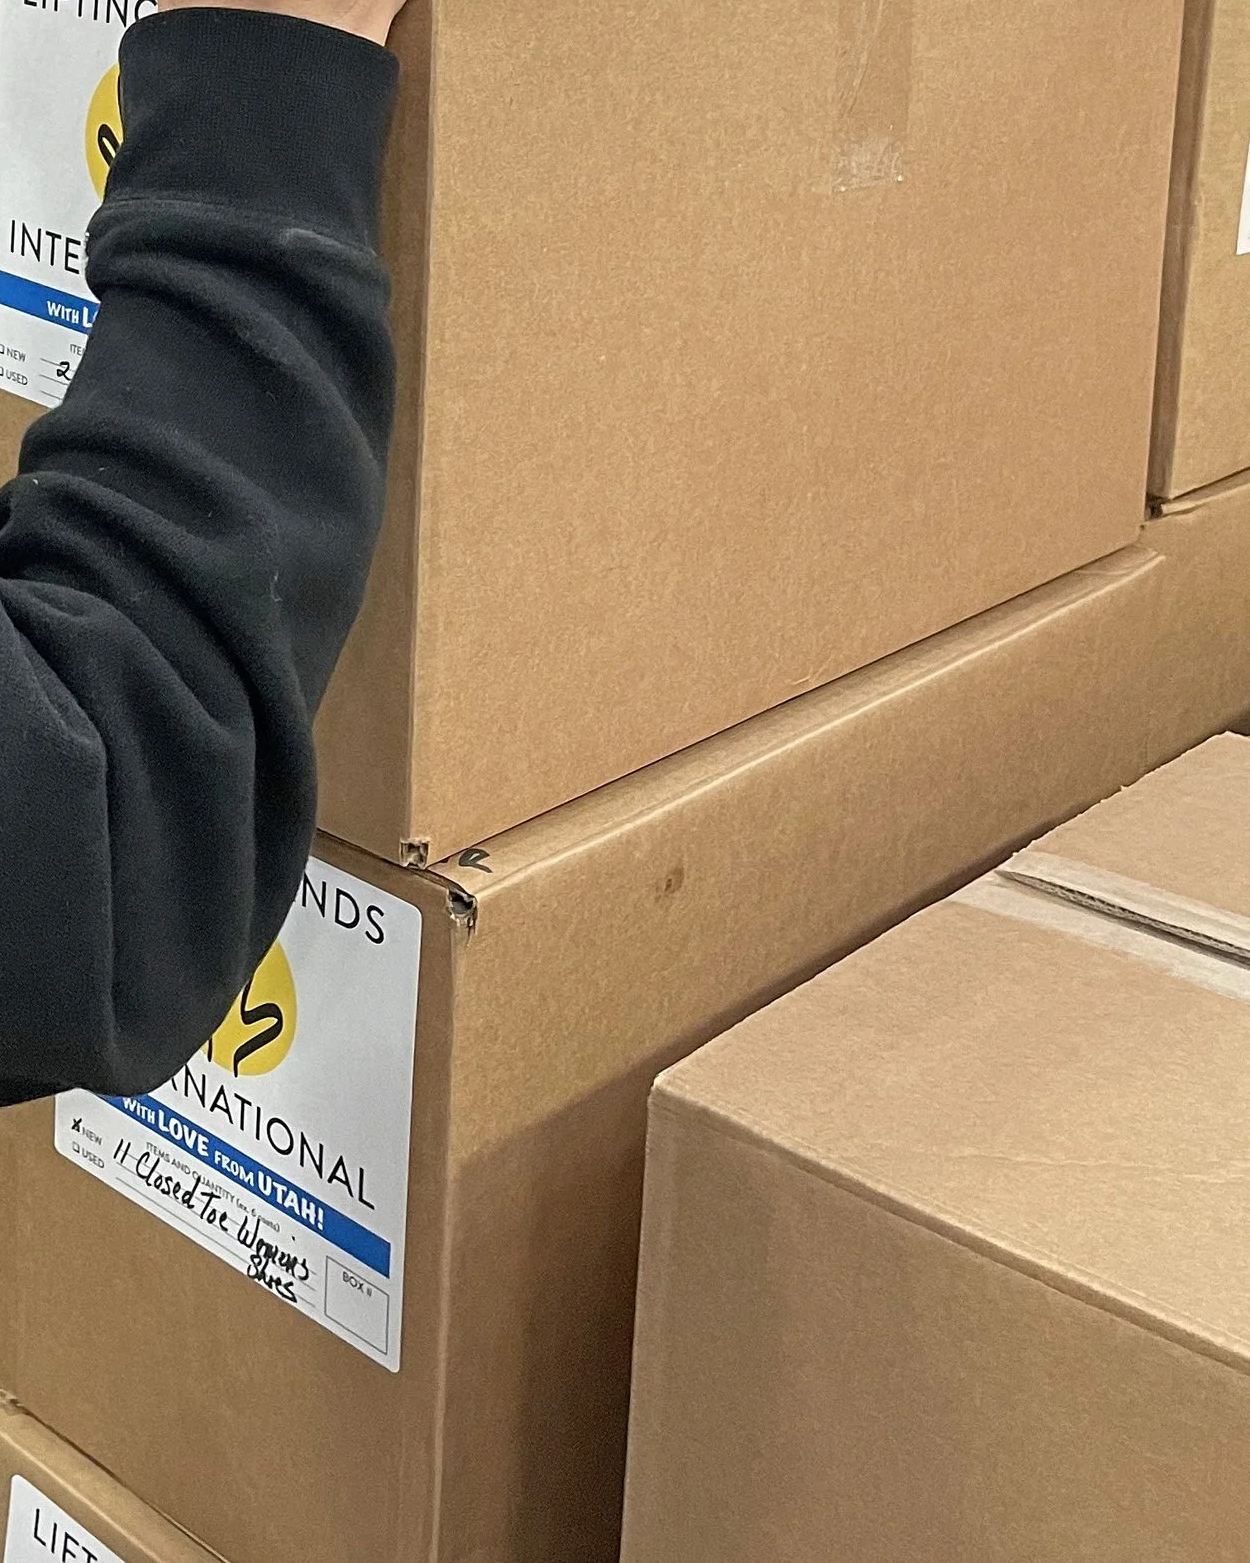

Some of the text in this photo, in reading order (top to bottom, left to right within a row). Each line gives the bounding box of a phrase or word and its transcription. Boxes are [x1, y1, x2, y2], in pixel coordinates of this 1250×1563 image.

[46, 300, 80, 324] WITH
[6, 346, 26, 362] NEW
[70, 343, 86, 357] ITE
[5, 368, 29, 386] USED
[301, 872, 386, 945] NDS
[81, 1126, 103, 1146] NEW
[171, 1065, 376, 1211] NATIONAL
[81, 1147, 105, 1169] USED
[122, 1097, 325, 1232] WITH LOVE FROM UTAH!
[146, 1141, 171, 1163] ITEMS
[171, 1158, 191, 1176] AND
[135, 1151, 203, 1210] Closed
[342, 1270, 364, 1292] BOX
